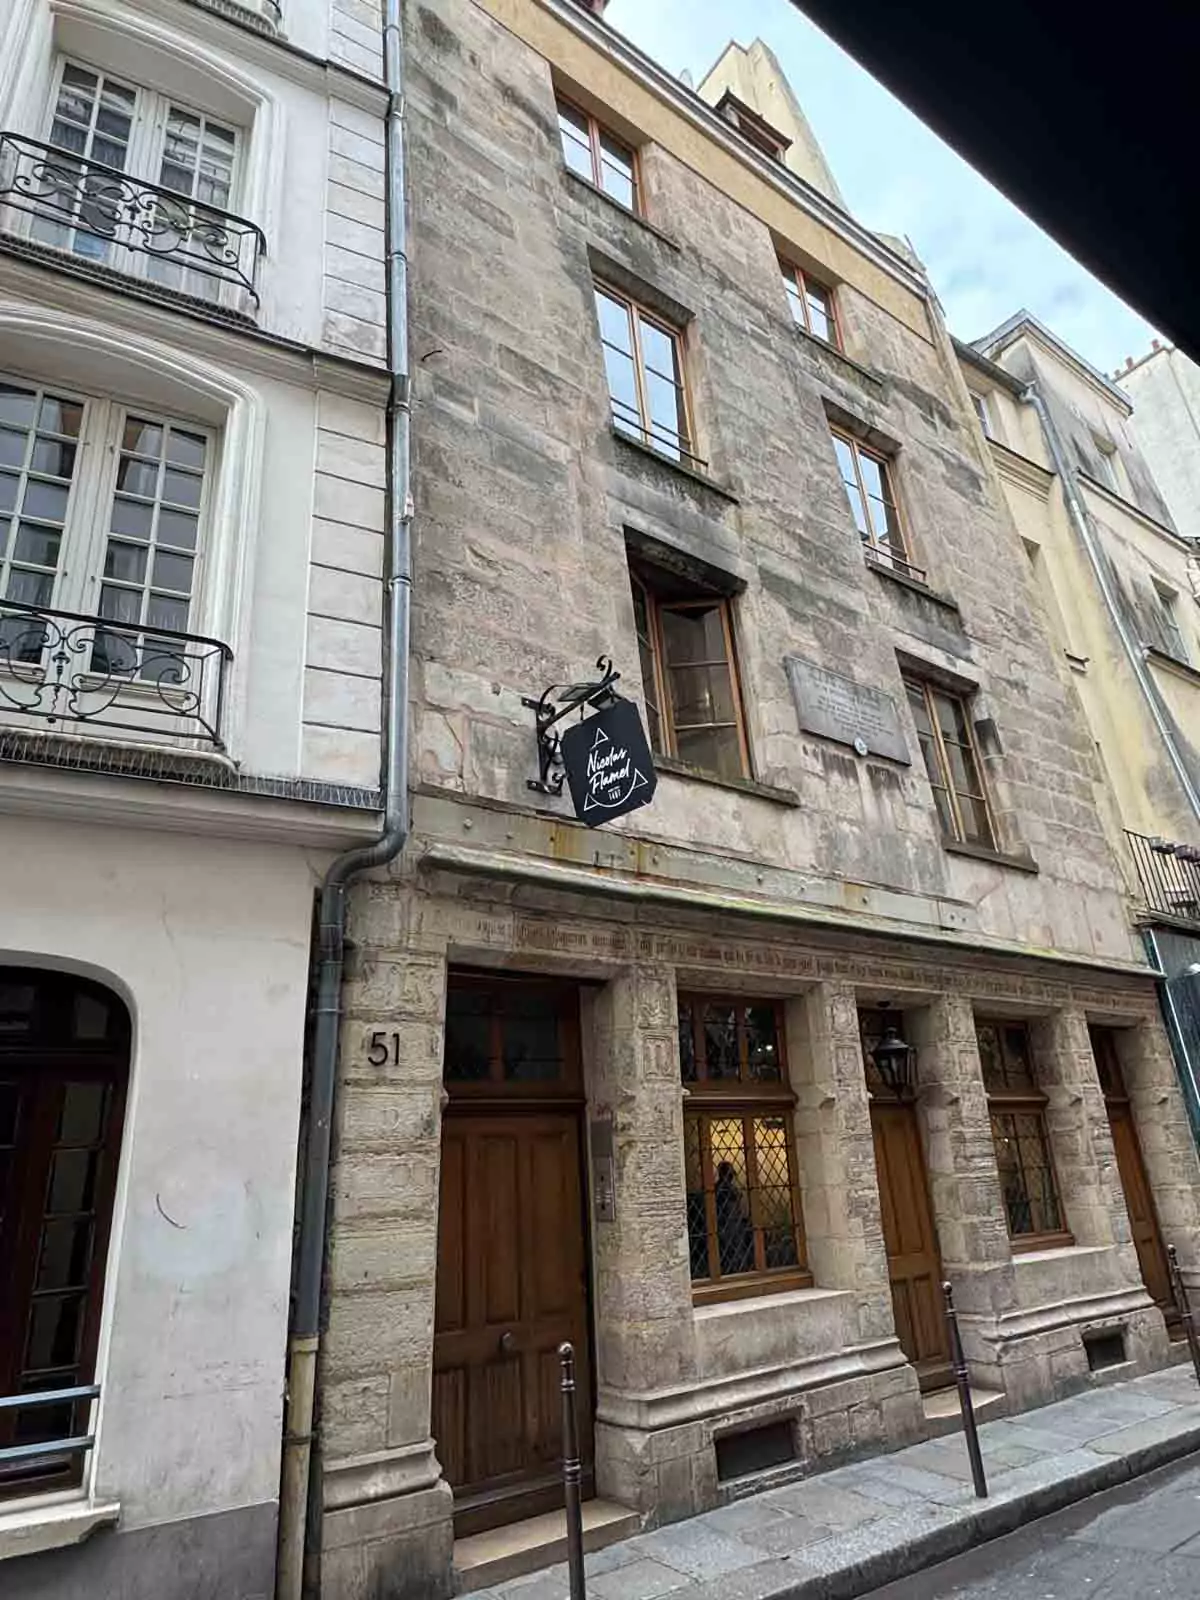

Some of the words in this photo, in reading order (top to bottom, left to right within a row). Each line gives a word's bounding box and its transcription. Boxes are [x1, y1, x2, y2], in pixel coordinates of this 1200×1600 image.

[587, 747, 627, 777] Nicolas
[589, 758, 631, 794] Flamel
[368, 1032, 400, 1067] 51
